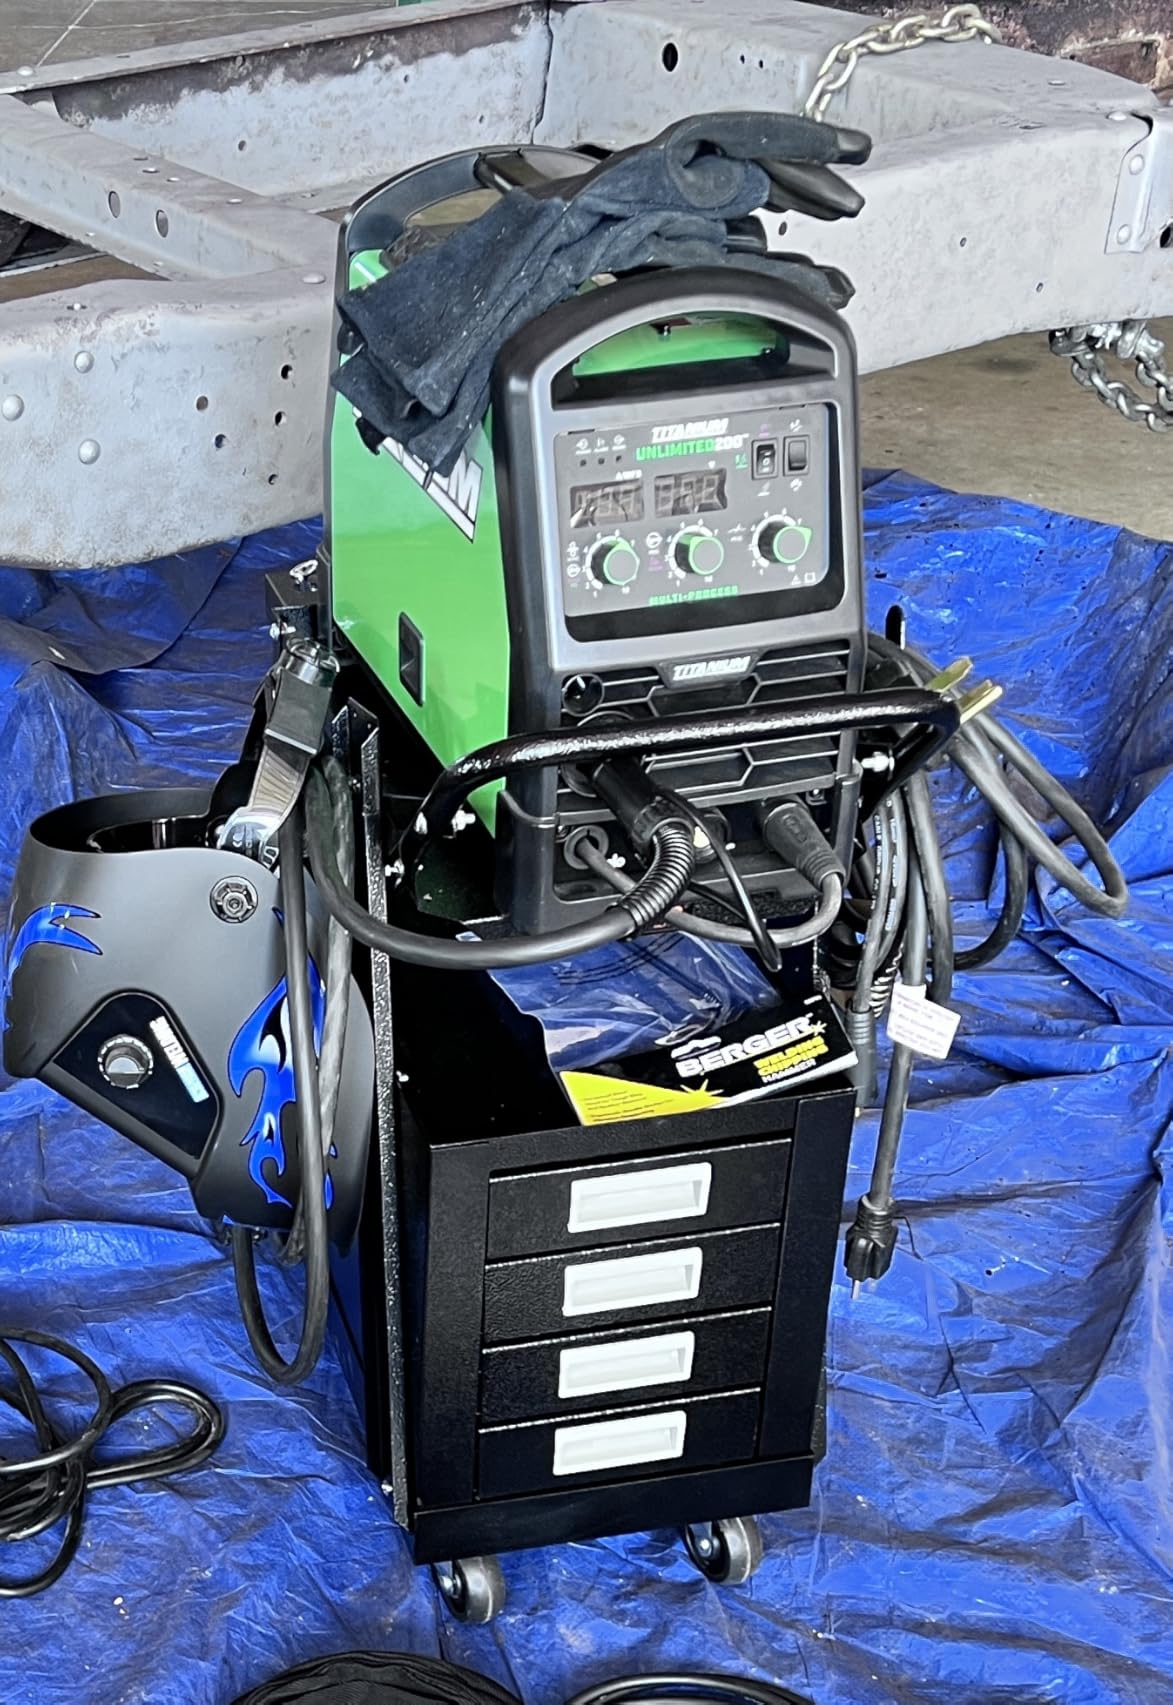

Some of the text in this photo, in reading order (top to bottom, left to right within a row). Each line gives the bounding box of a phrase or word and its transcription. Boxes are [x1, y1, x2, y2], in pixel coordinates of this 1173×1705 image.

[651, 418, 728, 443] TITANIUM
[673, 656, 750, 680] TITANIUM
[675, 1016, 813, 1078] BERGER
[753, 1036, 825, 1068] WELDING
[761, 1058, 816, 1083] HAMMER
